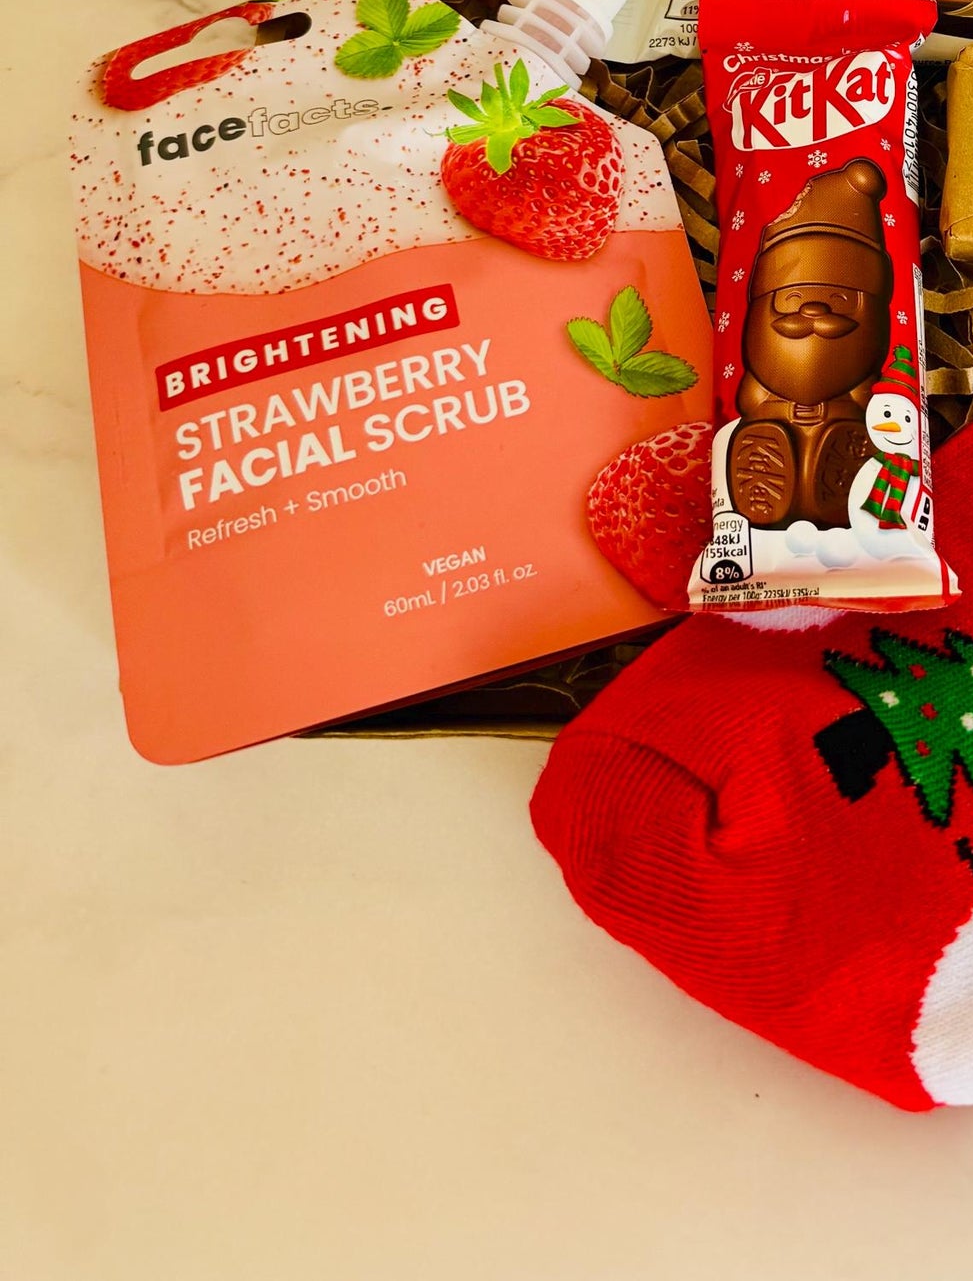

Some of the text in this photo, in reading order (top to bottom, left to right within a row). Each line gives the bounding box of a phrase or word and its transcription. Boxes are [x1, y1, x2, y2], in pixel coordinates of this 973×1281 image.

[649, 36, 676, 48] 2273
[677, 36, 691, 47] kJ
[723, 53, 833, 73] Christmas
[737, 52, 893, 149] KitKat
[165, 297, 449, 399] BRIGHTENING
[175, 339, 492, 462] STRAWBERRY
[179, 379, 531, 511] FACIAL SCRUB
[187, 506, 278, 551] Refresh
[307, 469, 408, 513] Smooth
[423, 546, 487, 577] VEGAN
[705, 545, 747, 558] 155kcal
[452, 575, 491, 598] 2.03
[715, 566, 740, 580] 8%
